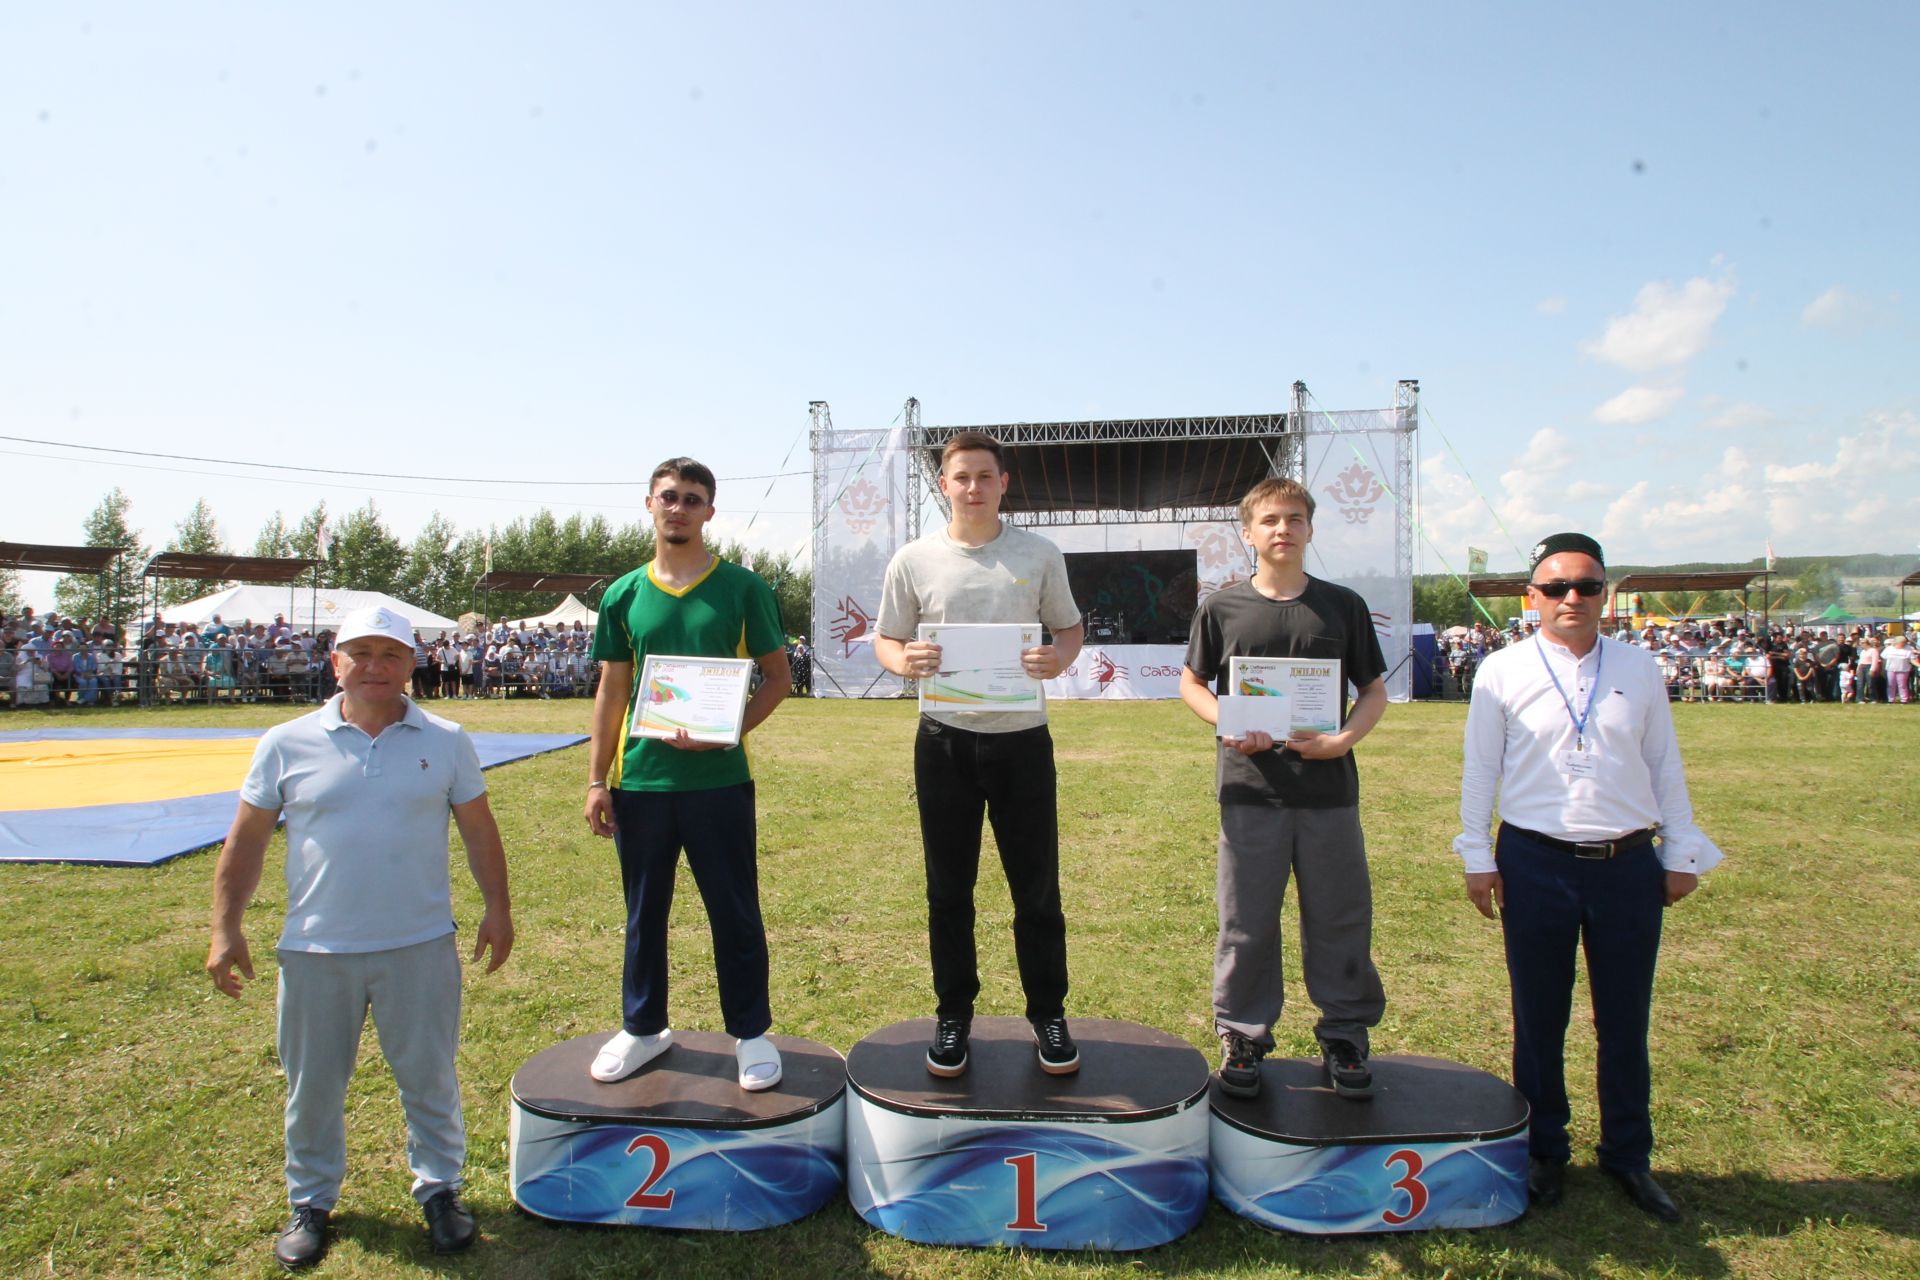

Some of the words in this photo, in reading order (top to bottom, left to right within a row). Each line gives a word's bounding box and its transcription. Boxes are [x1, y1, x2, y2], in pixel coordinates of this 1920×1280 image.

[1140, 665, 1183, 677] Саба
[1290, 667, 1331, 678] ДИПЛОМ
[624, 1134, 675, 1211] 2
[1004, 1152, 1047, 1232] 1
[1381, 1148, 1429, 1226] 3
